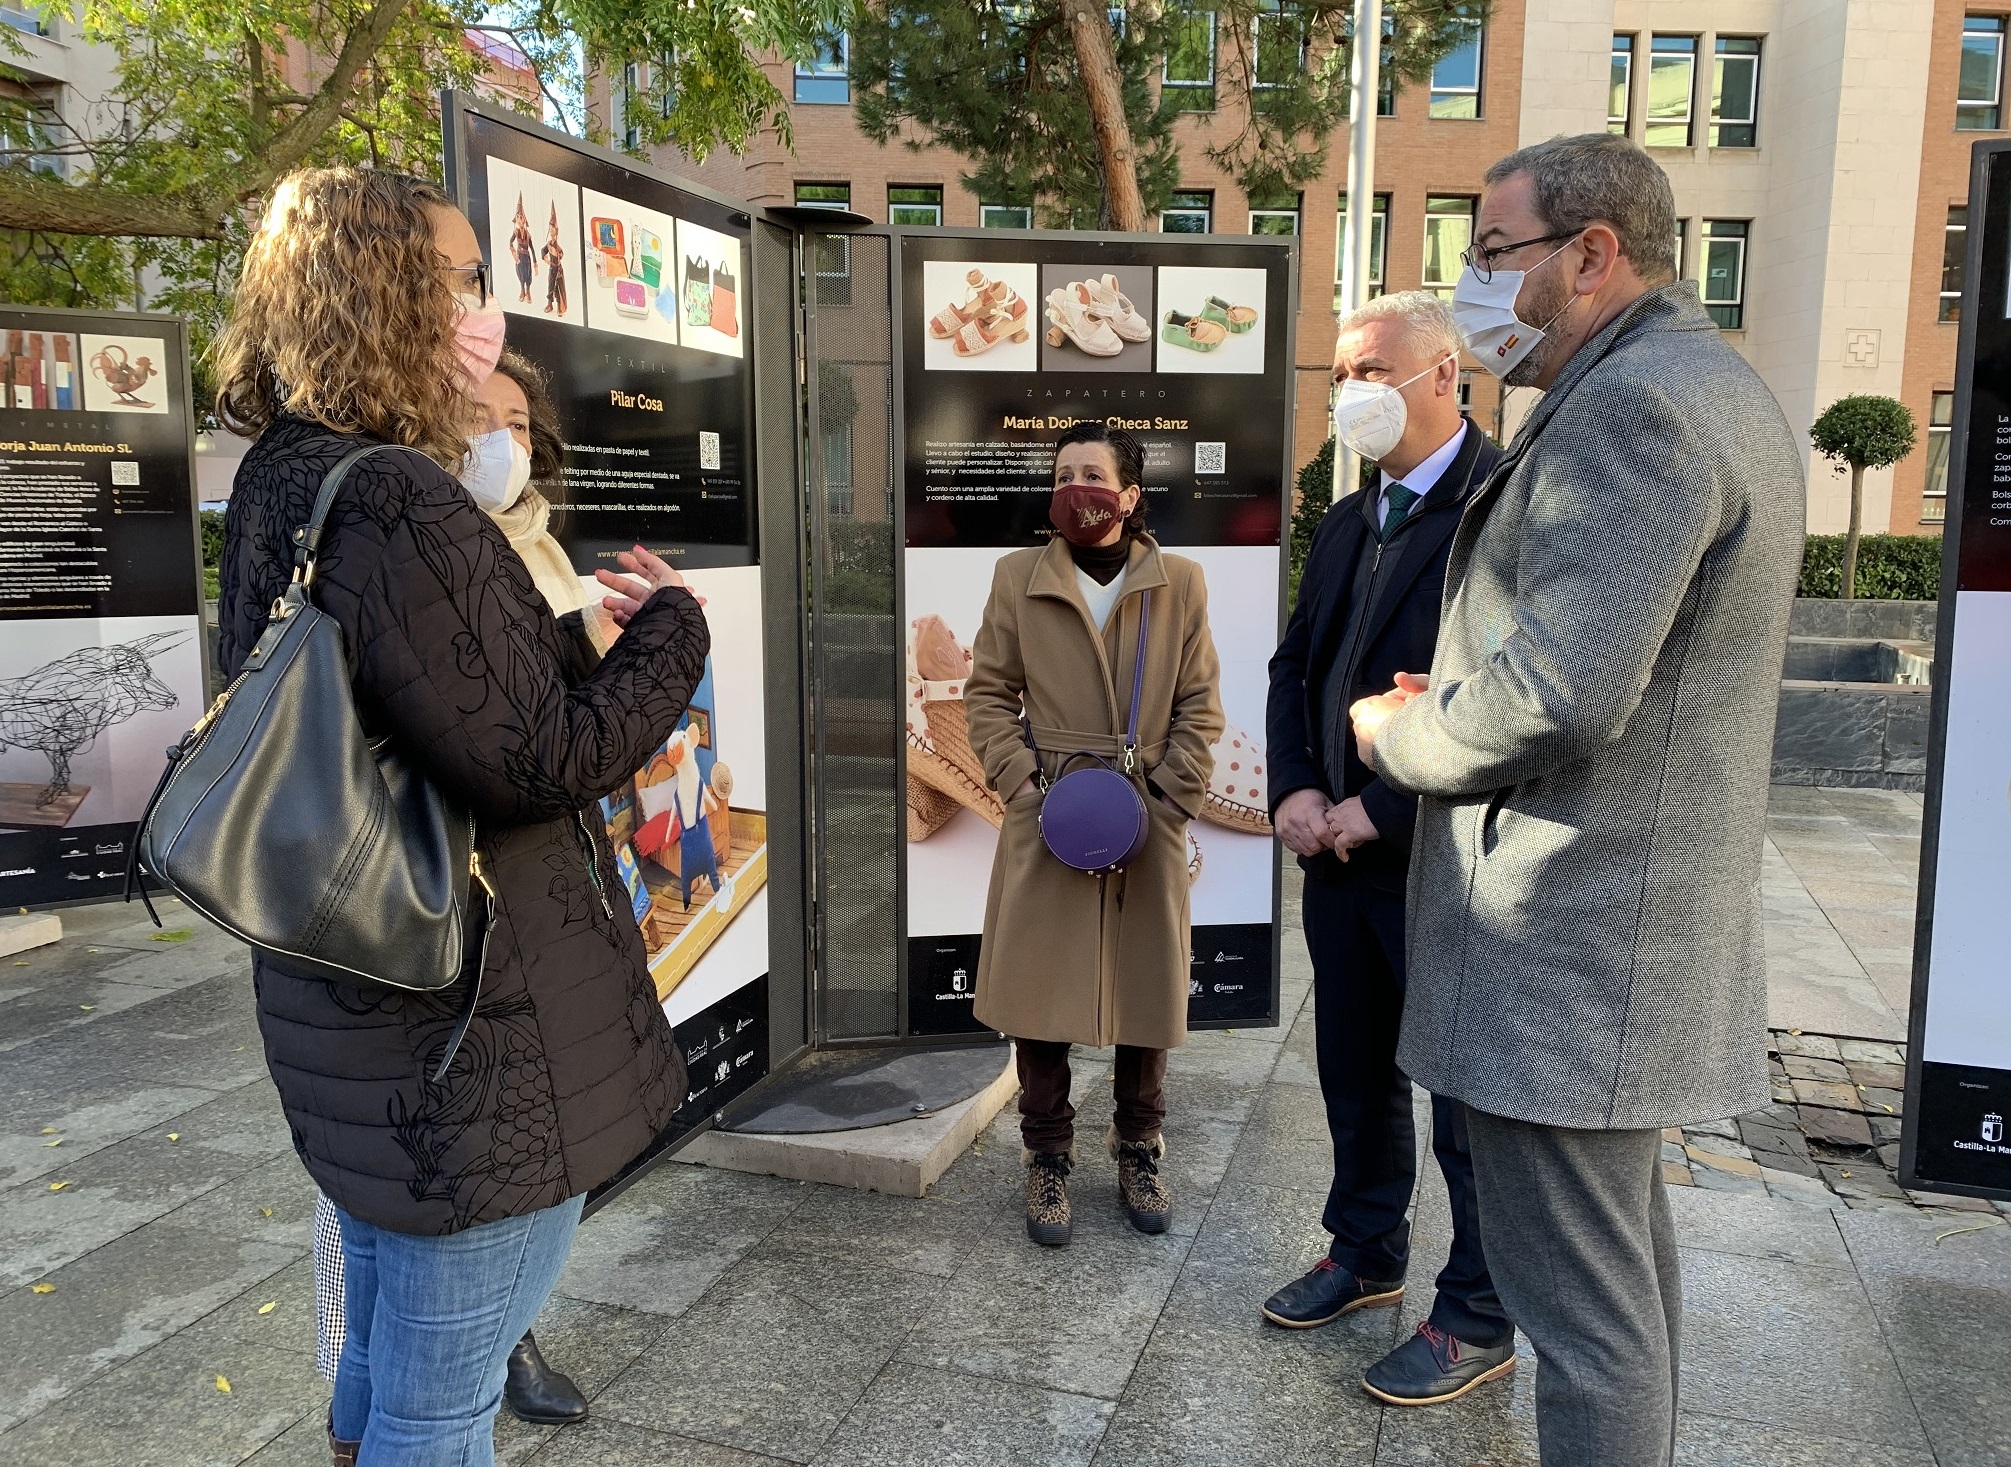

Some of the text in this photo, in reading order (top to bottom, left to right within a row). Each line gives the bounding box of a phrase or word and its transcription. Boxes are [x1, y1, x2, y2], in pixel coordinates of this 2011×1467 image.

[604, 354, 665, 374] TEXTIL
[1026, 389, 1166, 398] ZAPATERO
[610, 389, 664, 412] Pilar Cosa
[1002, 416, 1044, 429] María
[1106, 416, 1151, 430] Checa
[1154, 416, 1189, 430] Sanz
[1998, 414, 2009, 423] La
[46, 421, 111, 430] METAL
[28, 441, 61, 452] Juan
[63, 442, 115, 453] Antonio
[925, 440, 948, 448] Realizo
[948, 440, 975, 448] artesanía
[985, 441, 1010, 449] calzado,
[966, 459, 1004, 467] personalizar.
[1005, 459, 1033, 467] Dispongo
[931, 467, 951, 475] sénior,
[1994, 465, 2011, 473] zap
[974, 485, 995, 493] amplia
[1213, 982, 1244, 993] Cámara
[935, 993, 964, 1001] Castilla-La
[1953, 1140, 1997, 1153] Castilla-La
